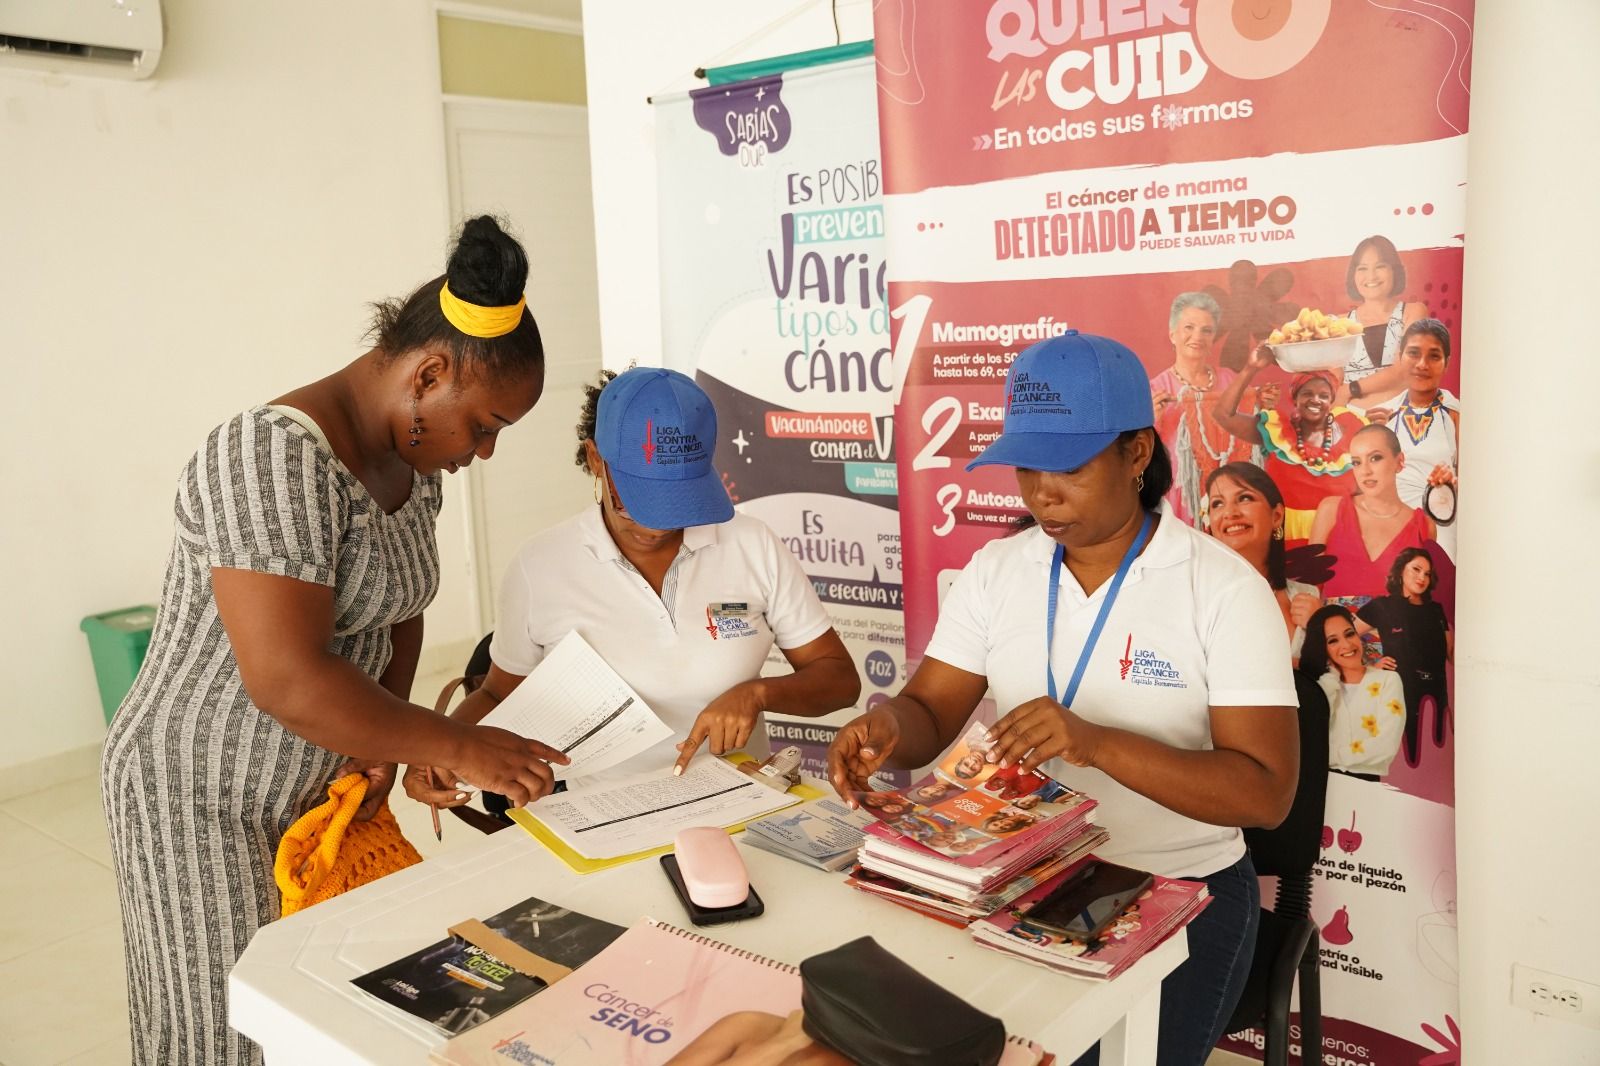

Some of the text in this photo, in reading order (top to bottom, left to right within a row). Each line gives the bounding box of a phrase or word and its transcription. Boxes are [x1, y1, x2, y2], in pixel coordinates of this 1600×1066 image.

[991, 67, 1043, 112] LAS
[994, 128, 1021, 150] En
[1028, 116, 1096, 145] todas
[1102, 112, 1144, 136] sus
[1046, 174, 1248, 210] El cáncer de mama
[994, 195, 1297, 260] DETECTADO A TIEMPO
[1140, 228, 1296, 250] PUEDE SALVAR TU VIDA
[932, 317, 1068, 347] Mamografía
[891, 294, 933, 406] 1
[934, 354, 942, 364] A
[944, 353, 970, 367] partir
[972, 354, 985, 364] de
[987, 353, 1002, 364] los
[934, 366, 962, 378] hasta
[964, 366, 978, 378] los
[980, 366, 996, 380] 69,
[1014, 382, 1050, 393] CONTRA
[656, 427, 681, 435] LIGA
[656, 434, 698, 444] CONTRA
[912, 396, 962, 472] 2
[969, 432, 976, 441] A
[933, 484, 962, 536] 3
[967, 512, 984, 521] Una
[999, 514, 1006, 522] al
[886, 557, 894, 570] 9
[854, 618, 868, 628] del
[843, 631, 865, 640] para
[1134, 650, 1156, 660] LIGA
[1134, 658, 1172, 670] CONTRA
[868, 658, 892, 677] 70%
[1132, 666, 1180, 679] EL CANCER
[765, 722, 785, 738] Ten
[787, 728, 804, 740] en
[1338, 860, 1355, 872] de
[1358, 862, 1402, 881] líquido
[1326, 869, 1348, 882] por
[1351, 873, 1363, 884] el
[1366, 876, 1406, 893] pezón
[1352, 956, 1360, 964] o
[1340, 962, 1384, 981] visible
[584, 984, 674, 1029] Cáncer de
[590, 1007, 672, 1044] SENO
